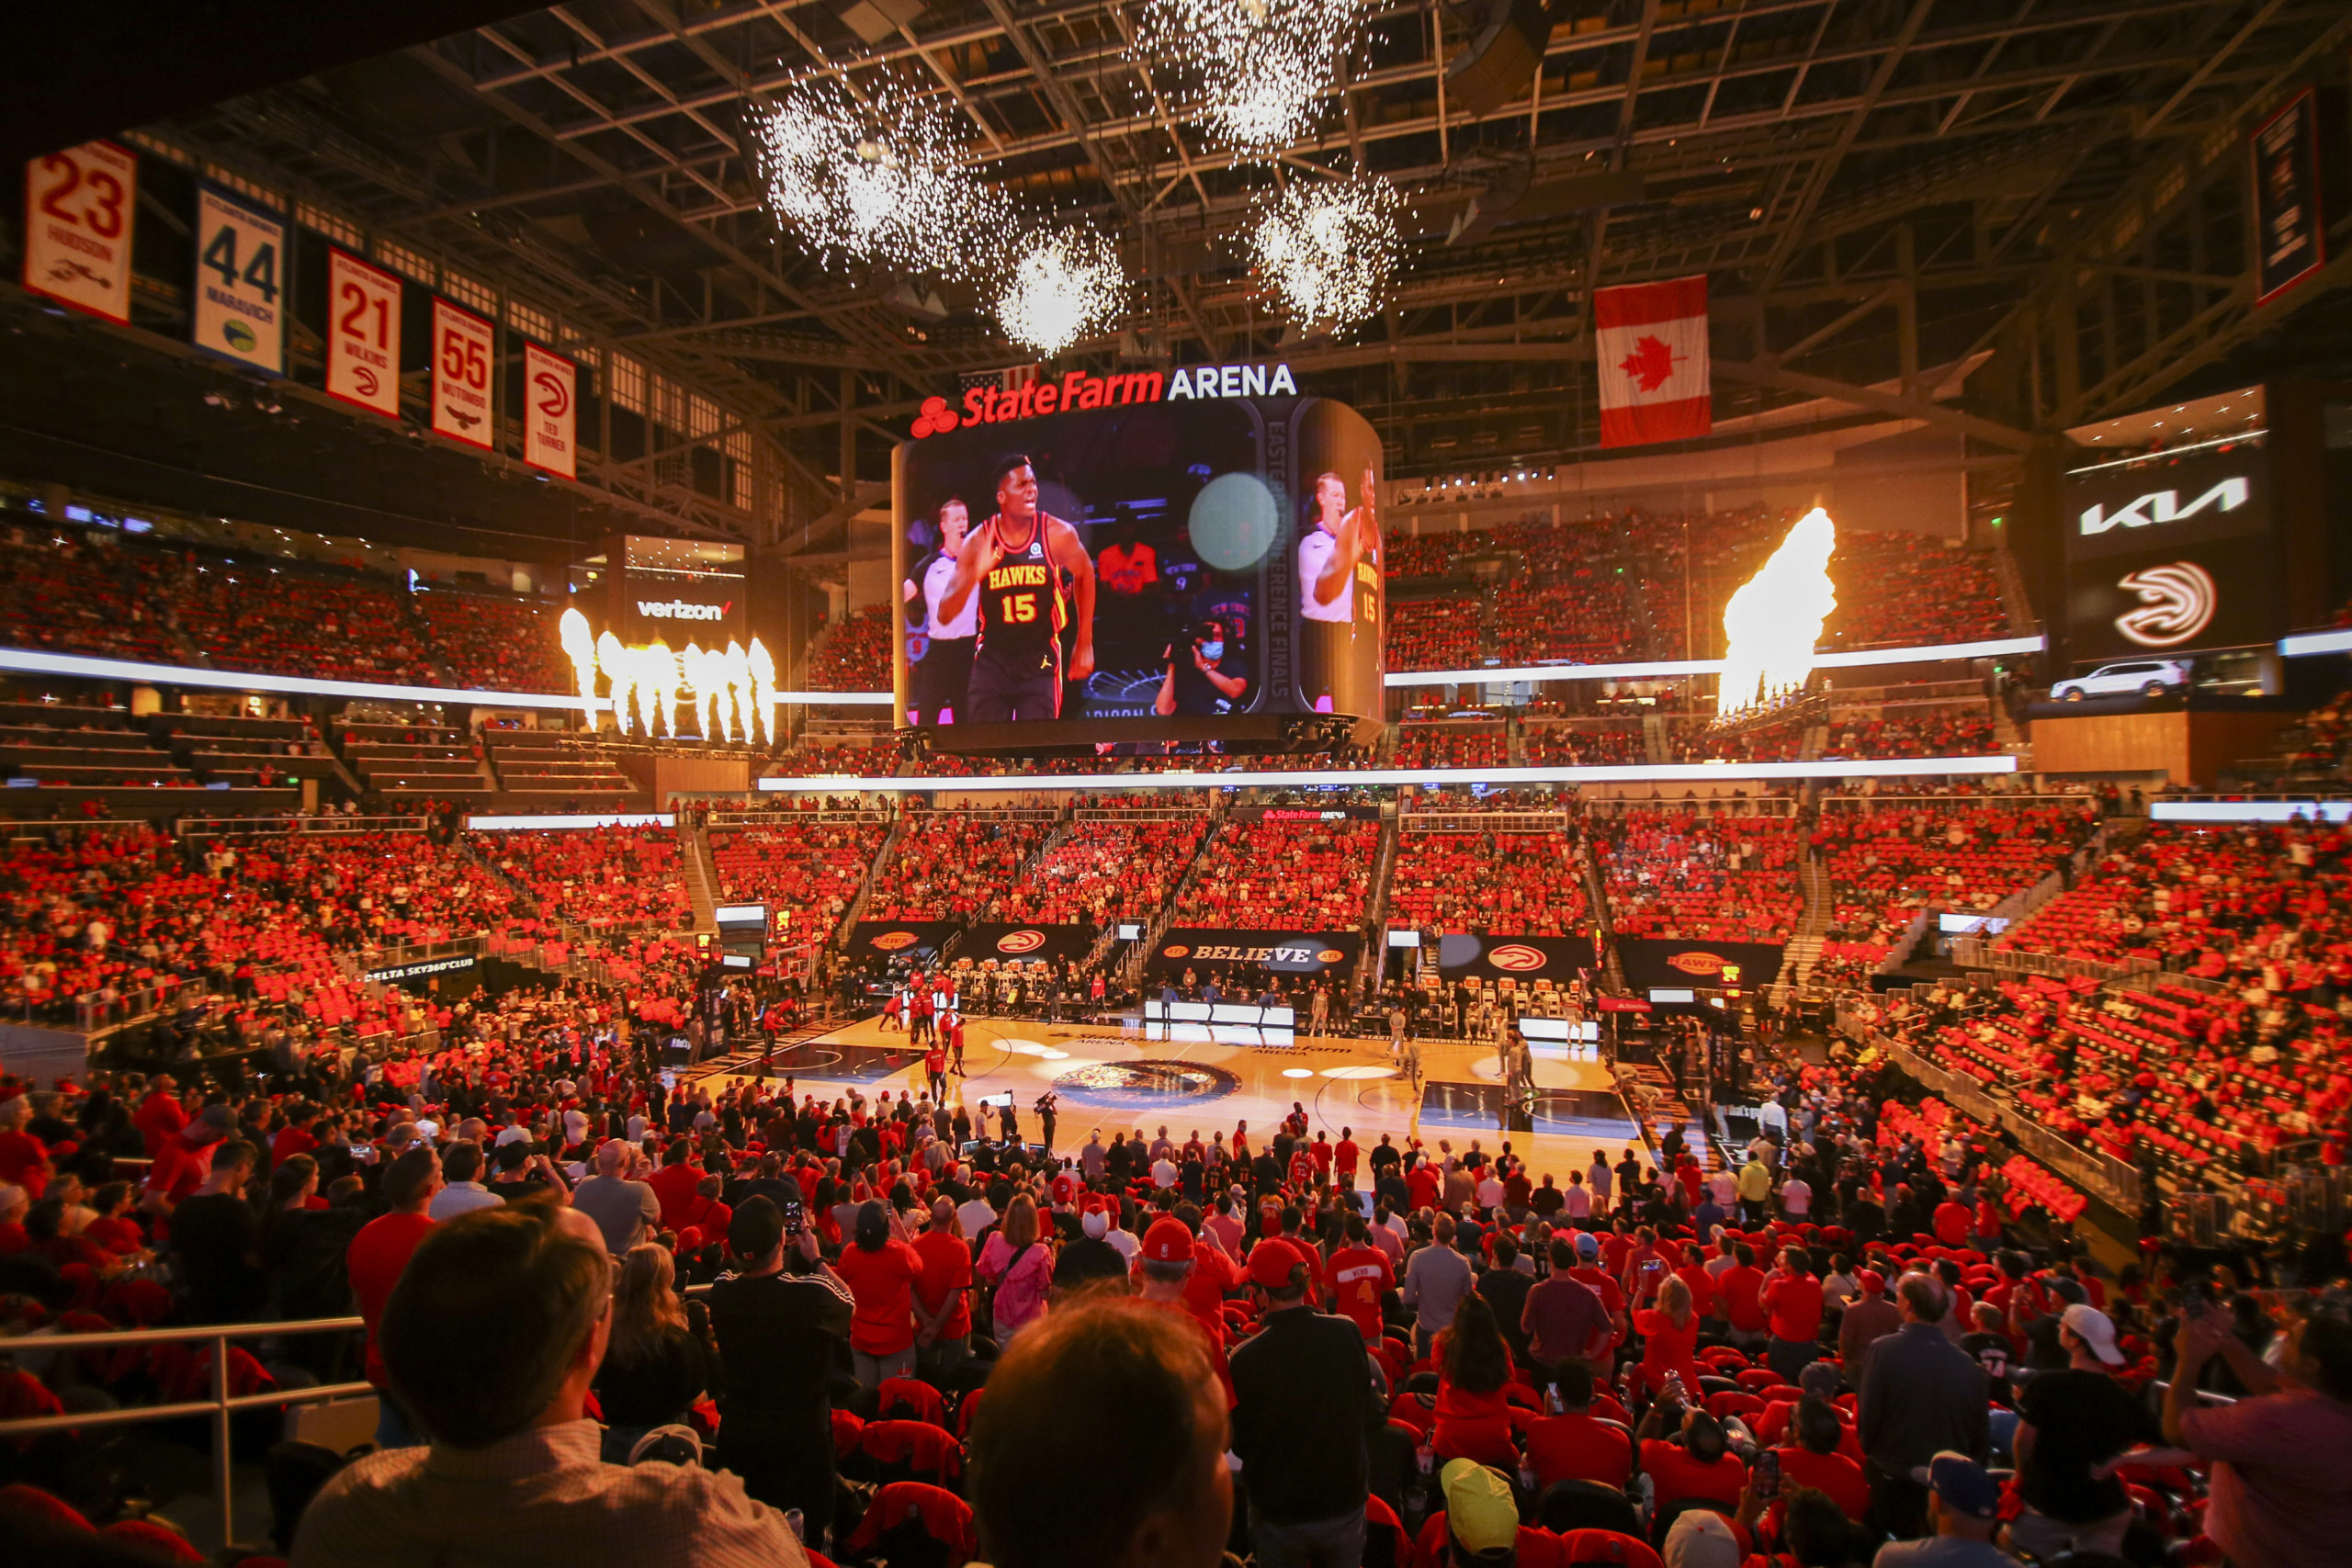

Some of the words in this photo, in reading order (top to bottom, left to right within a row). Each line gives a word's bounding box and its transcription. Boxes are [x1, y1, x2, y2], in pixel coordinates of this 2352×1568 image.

[40, 152, 125, 240] 23
[48, 224, 113, 263] HUDSON
[202, 225, 279, 305] 44
[206, 285, 274, 325] MARAVICH
[340, 281, 389, 351] 21
[344, 341, 389, 370] WILKINS
[441, 327, 487, 391] 55
[441, 380, 486, 410] MUTOMBO
[1168, 364, 1297, 401] ARENA
[537, 432, 567, 453] TURNER
[543, 421, 559, 436] TED
[1268, 421, 1286, 507] EASTERN
[989, 564, 1046, 591] HAWKS
[637, 599, 723, 621] verizon
[1001, 593, 1036, 624] 15
[1363, 592, 1376, 624] 15
[1271, 636, 1289, 698] FINALS
[1320, 811, 1346, 819] ARENA
[869, 932, 919, 945] HAWKS
[1167, 947, 1186, 955] ATL
[1193, 945, 1312, 964] BELIEVE
[364, 969, 405, 983] DELTA
[1351, 1268, 1368, 1277] WEBB
[1357, 1280, 1374, 1303] 4
